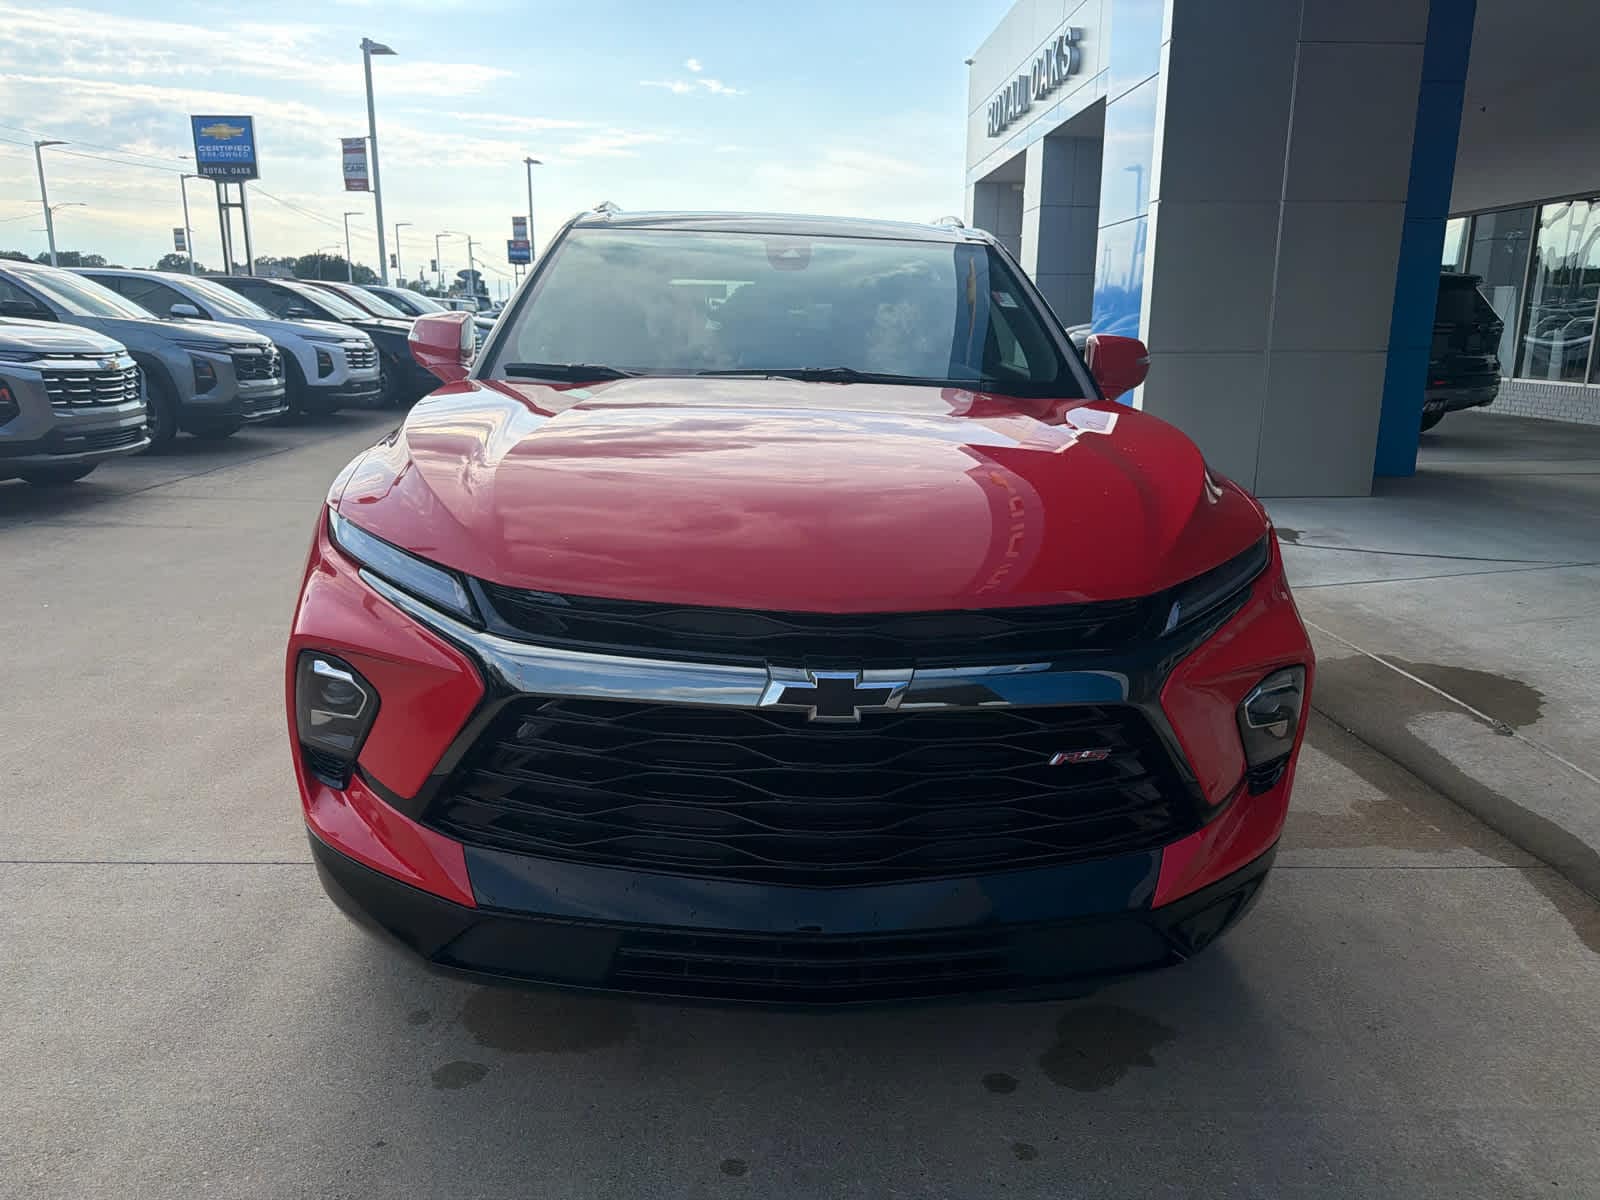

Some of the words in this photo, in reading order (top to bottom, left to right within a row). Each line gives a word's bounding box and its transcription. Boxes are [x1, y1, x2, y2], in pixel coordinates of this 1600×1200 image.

[987, 74, 1030, 137] ROYAL
[1031, 26, 1083, 101] OAKS
[198, 144, 250, 152] CERTIFIED
[202, 167, 228, 175] ROYAL
